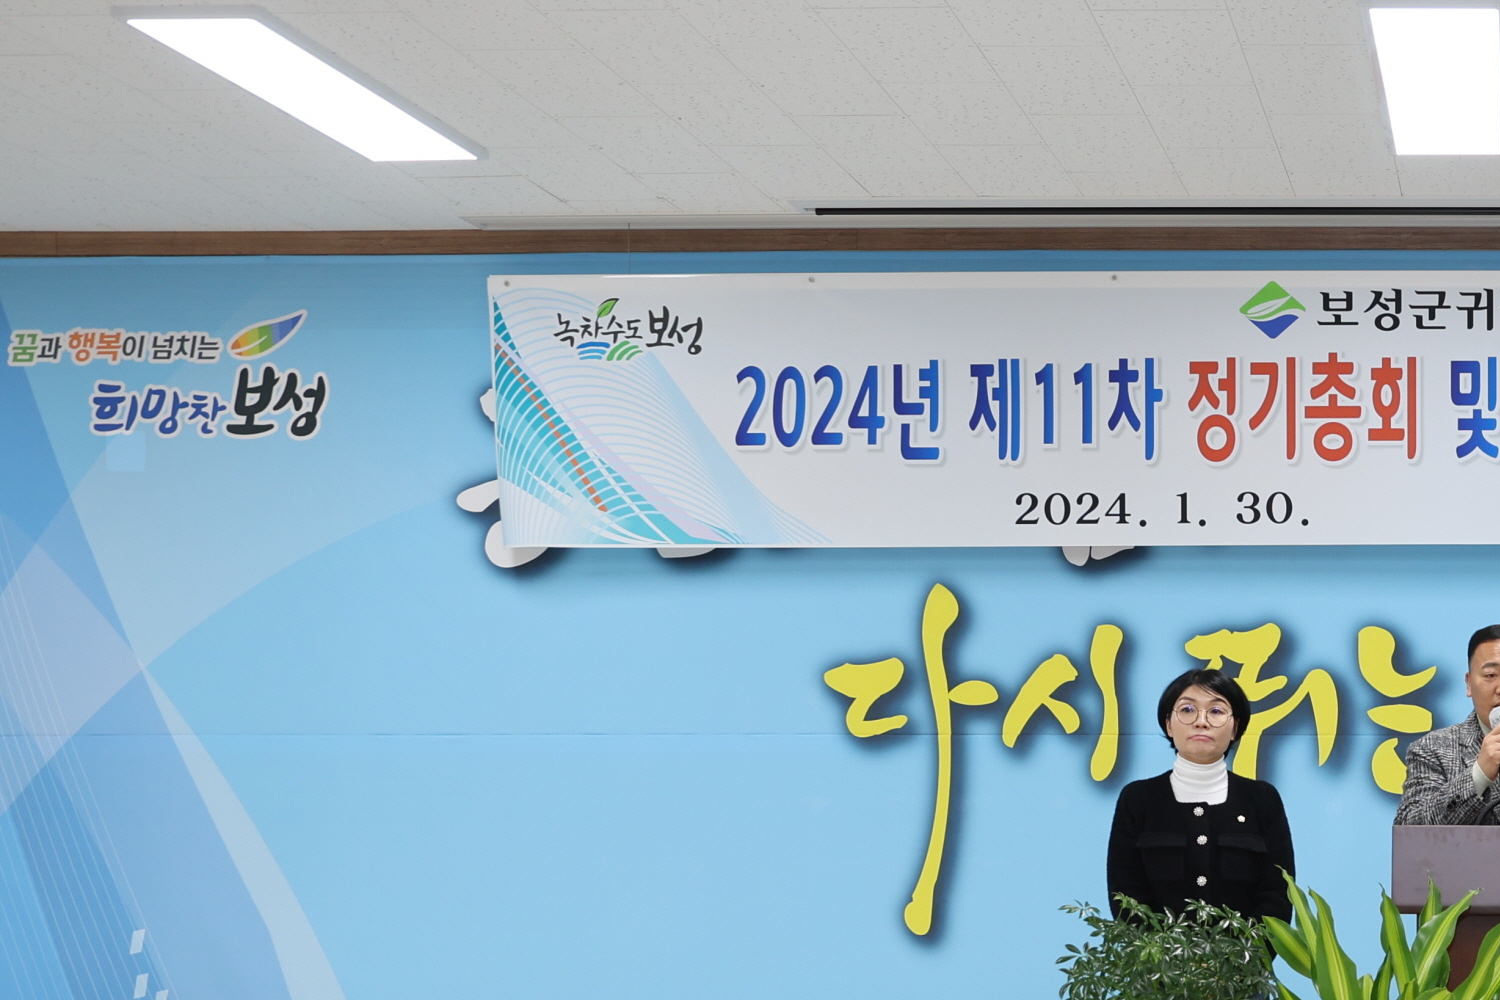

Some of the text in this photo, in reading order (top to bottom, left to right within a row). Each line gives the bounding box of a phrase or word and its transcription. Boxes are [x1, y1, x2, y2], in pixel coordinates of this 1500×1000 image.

[11, 331, 220, 363] 꿈과 행복이 넘치는
[553, 304, 704, 356] 녹차수도 보성
[93, 366, 327, 437] 희망찬 보성
[735, 358, 940, 462] 2024년
[969, 357, 1164, 462] 제11차
[1187, 352, 1418, 462] 정기총회
[1450, 356, 1500, 460] 및
[1015, 491, 1309, 528] 2024. 1. 30.
[824, 584, 1123, 936] 다시
